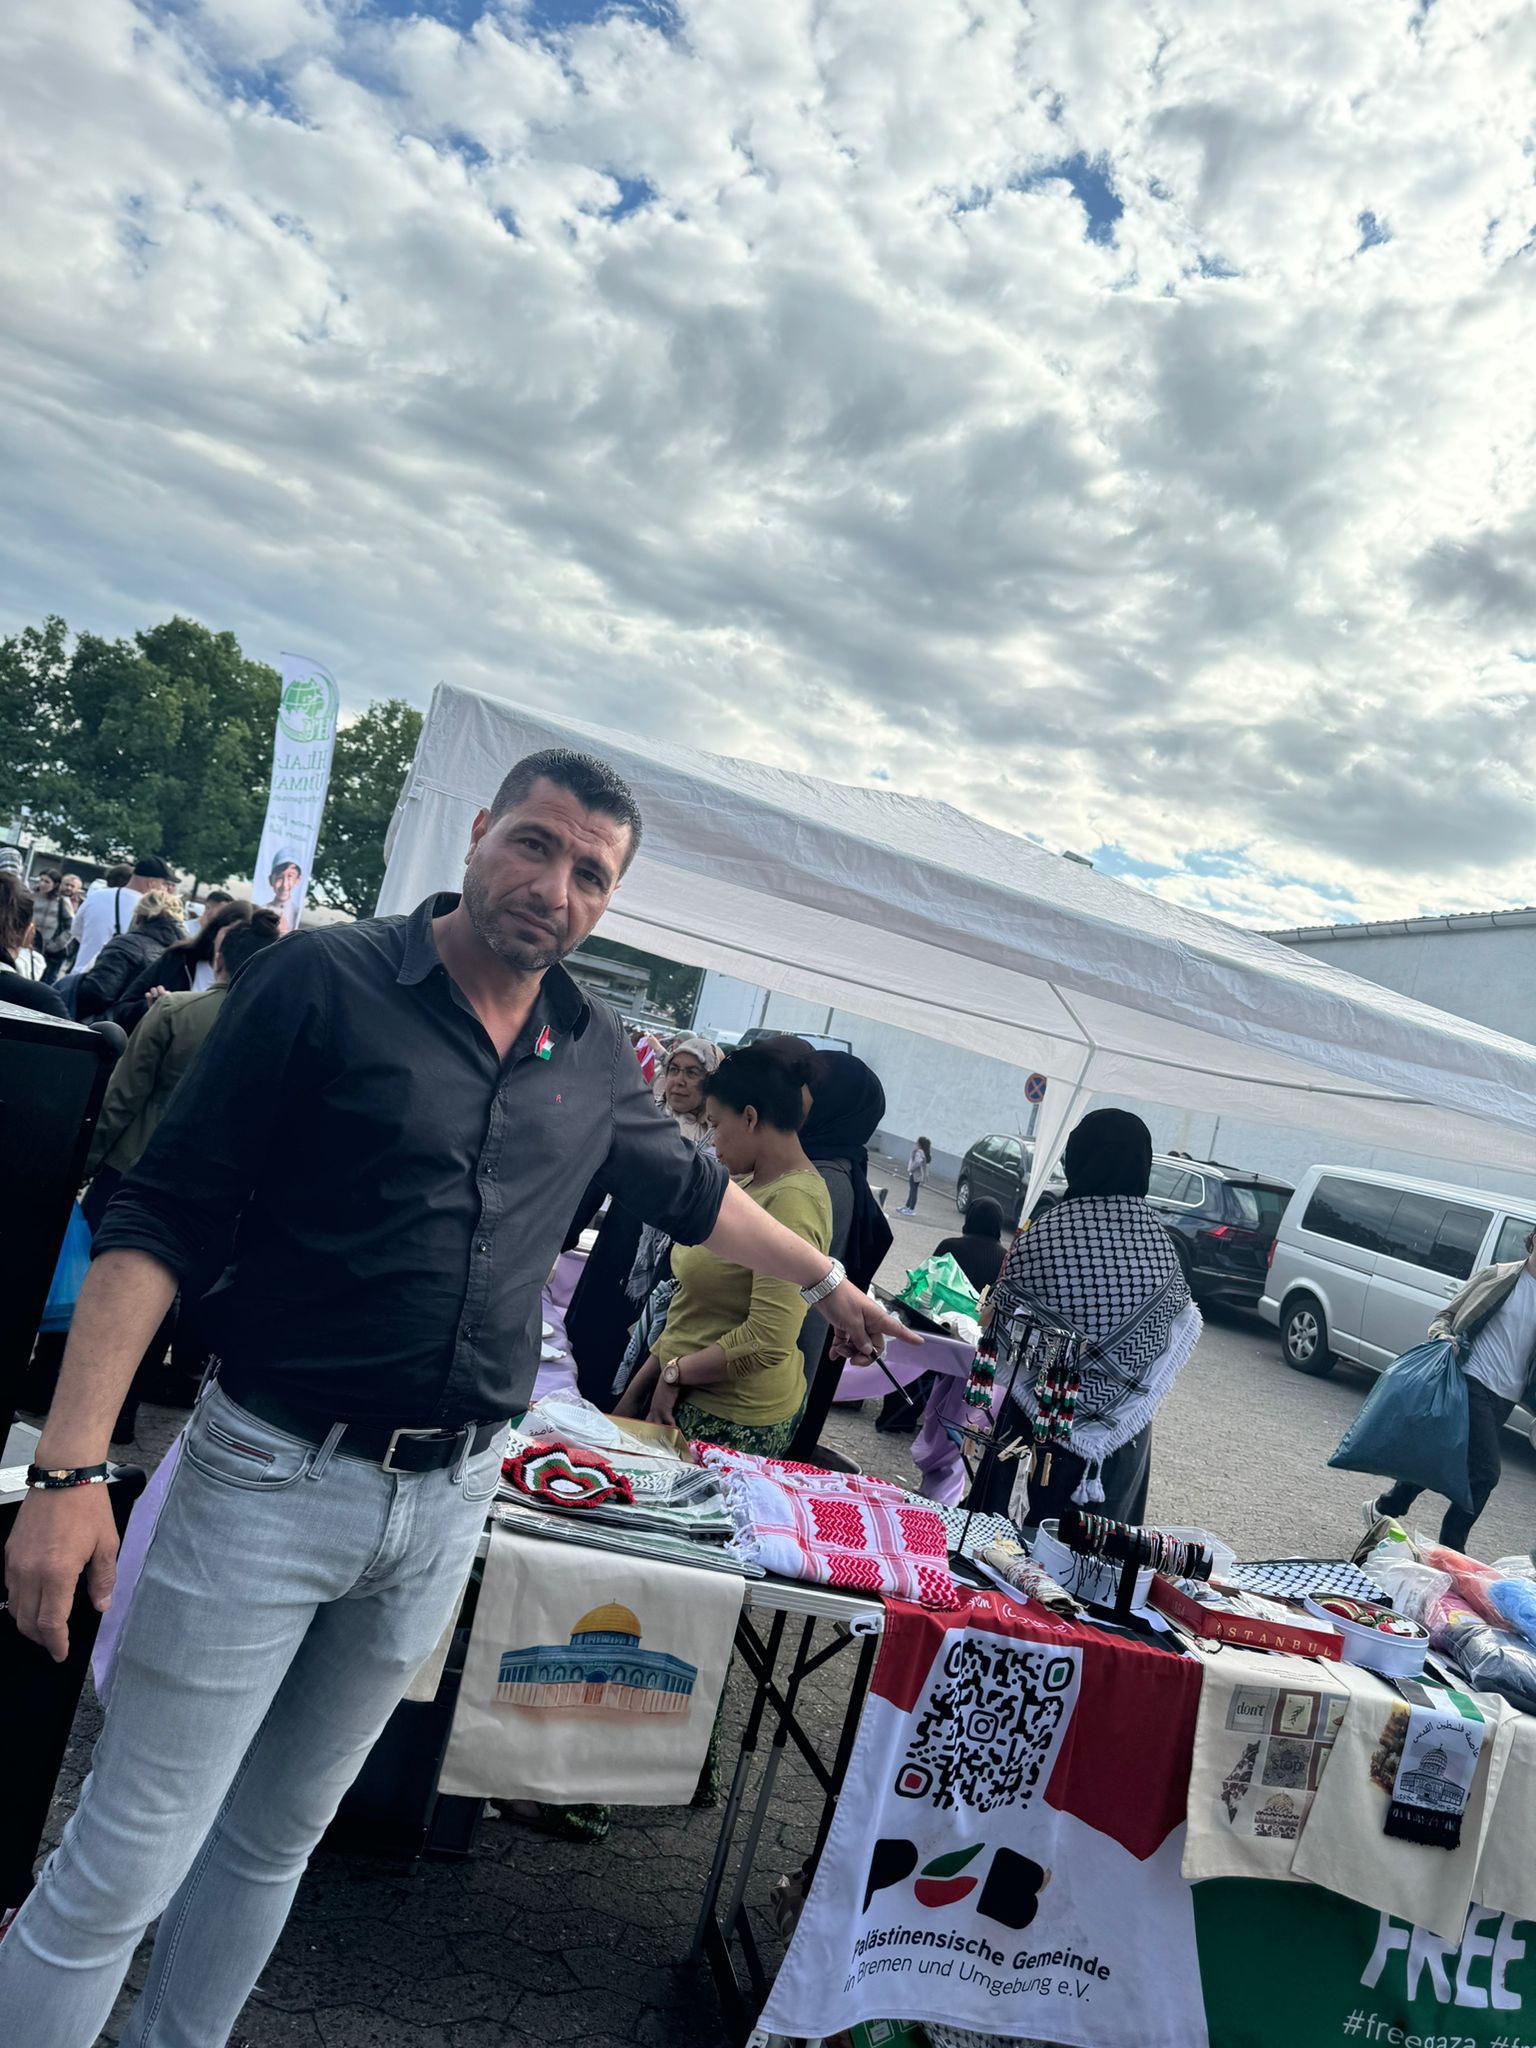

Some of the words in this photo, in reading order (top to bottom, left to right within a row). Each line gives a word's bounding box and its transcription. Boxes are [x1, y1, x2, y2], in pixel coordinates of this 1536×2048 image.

[1237, 1701, 1266, 1717] don't
[1413, 1721, 1433, 1744] القدس
[1437, 1720, 1465, 1732] فلسطين
[1272, 1756, 1305, 1773] stop
[852, 1926, 1005, 1966] Palästinensische
[1013, 1947, 1110, 1980] Gemeinde
[1360, 1902, 1526, 2010] FREE
[843, 1974, 856, 1993] in
[858, 1956, 912, 1983] Bremen
[918, 1959, 954, 1977] und
[959, 1962, 1053, 1996] Umgebung
[1058, 1980, 1091, 2002] e.V.
